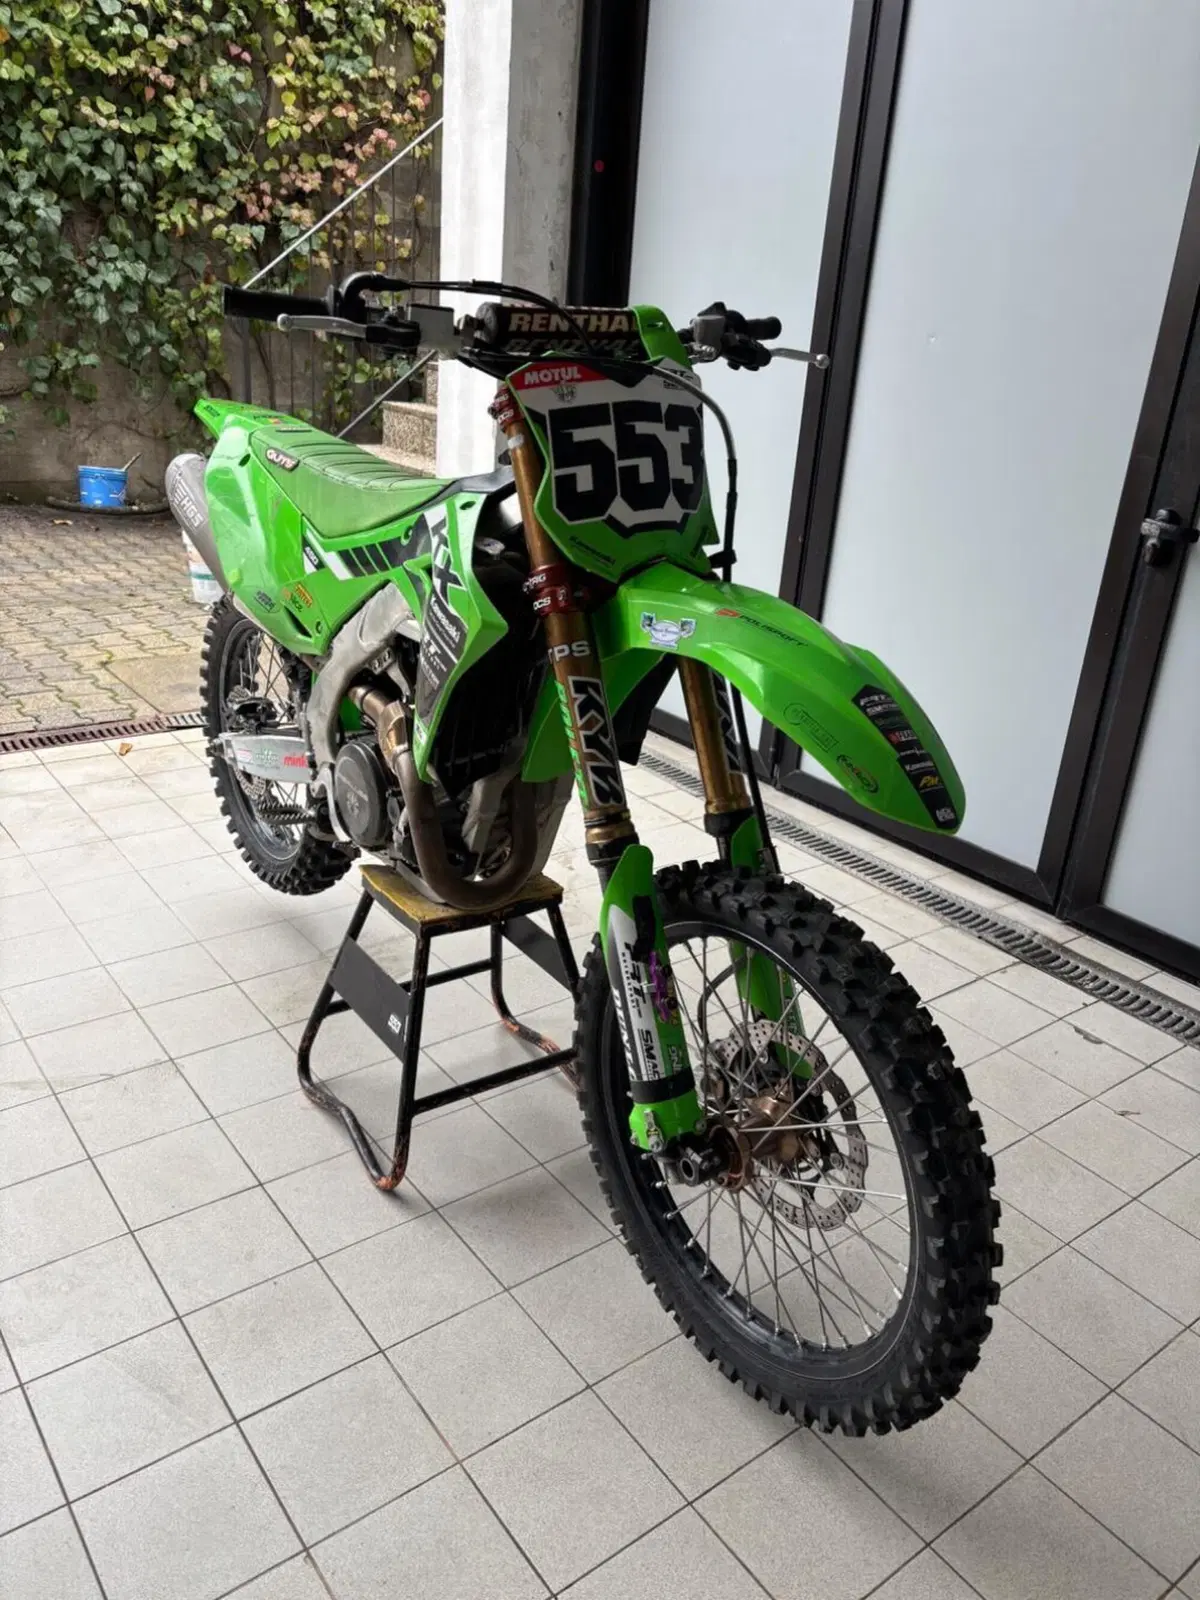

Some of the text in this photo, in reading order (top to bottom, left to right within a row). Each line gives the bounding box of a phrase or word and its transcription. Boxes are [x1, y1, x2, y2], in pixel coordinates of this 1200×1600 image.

[524, 366, 582, 385] MOTUL
[549, 401, 703, 522] 553
[431, 515, 465, 604] KX
[568, 676, 626, 806] KYB
[611, 988, 637, 1081] DUNLO
